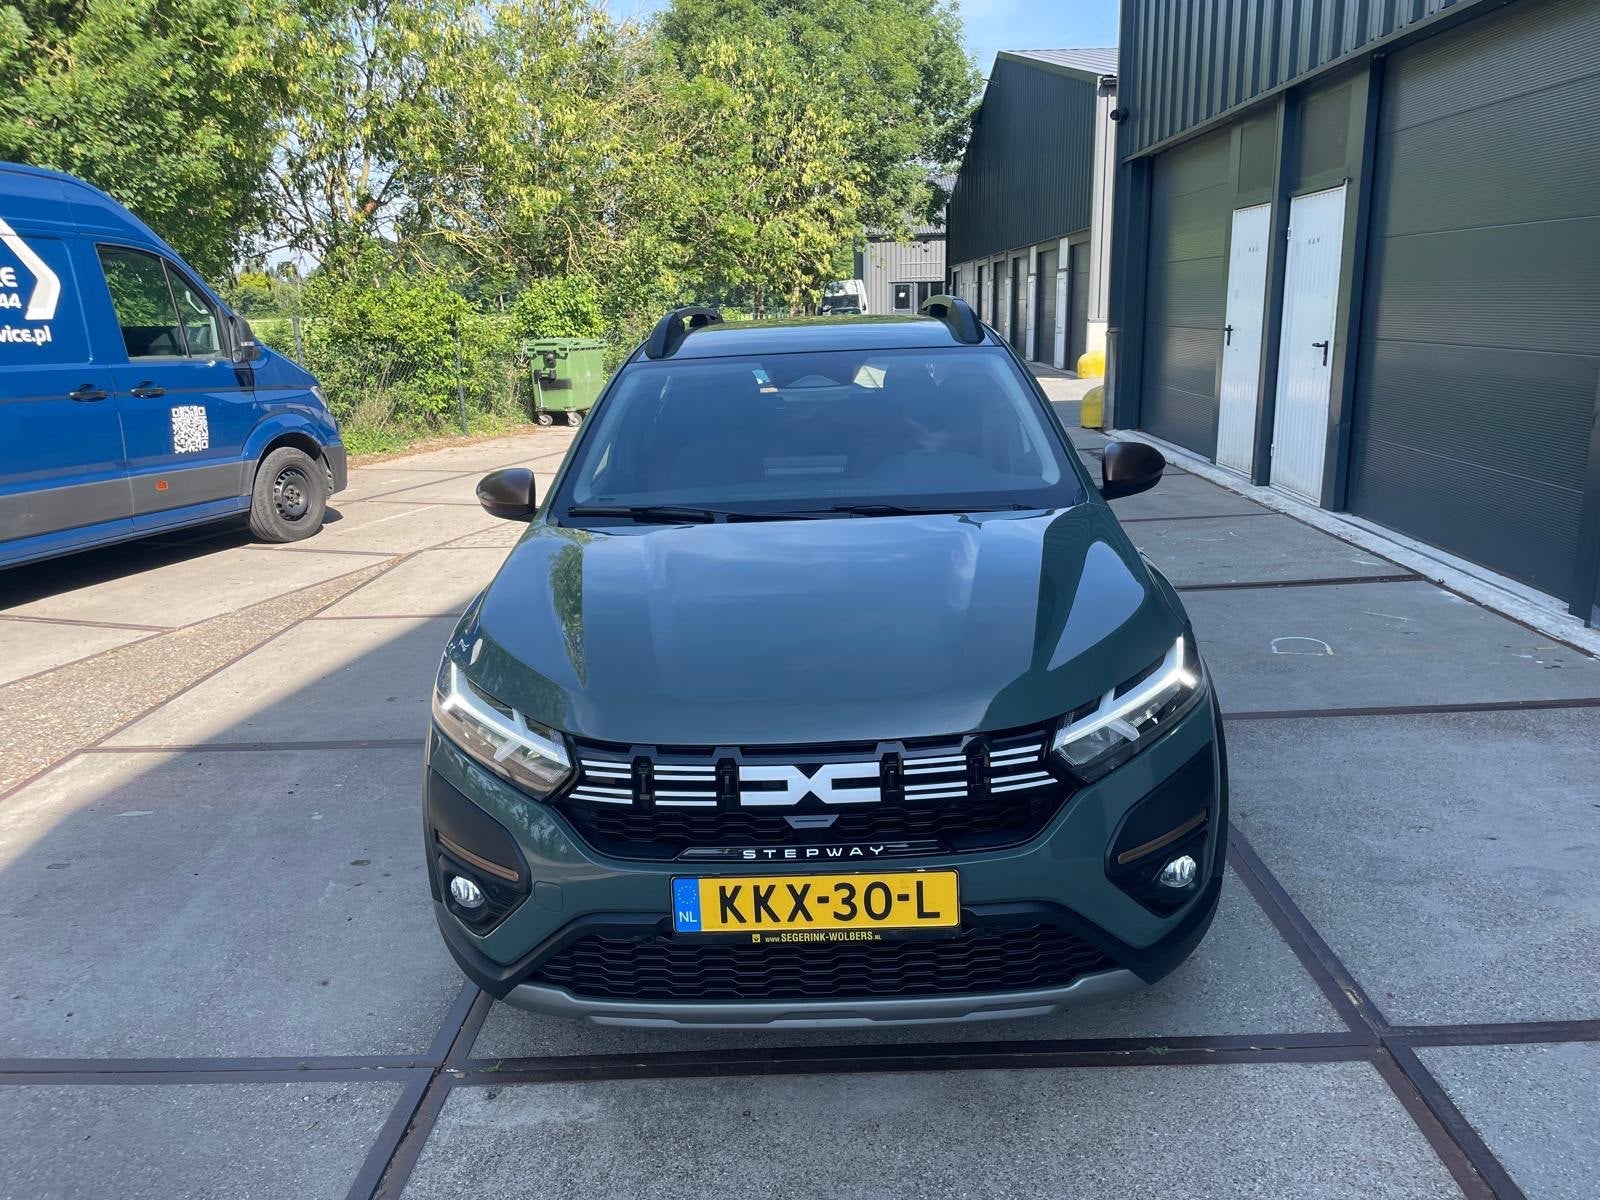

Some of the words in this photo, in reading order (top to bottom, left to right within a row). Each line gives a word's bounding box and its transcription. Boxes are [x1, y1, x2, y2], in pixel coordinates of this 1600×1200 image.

[0, 266, 18, 287] E
[742, 845, 884, 859] STEPWAY
[718, 880, 941, 924] KKX-30-L
[679, 911, 697, 923] NL
